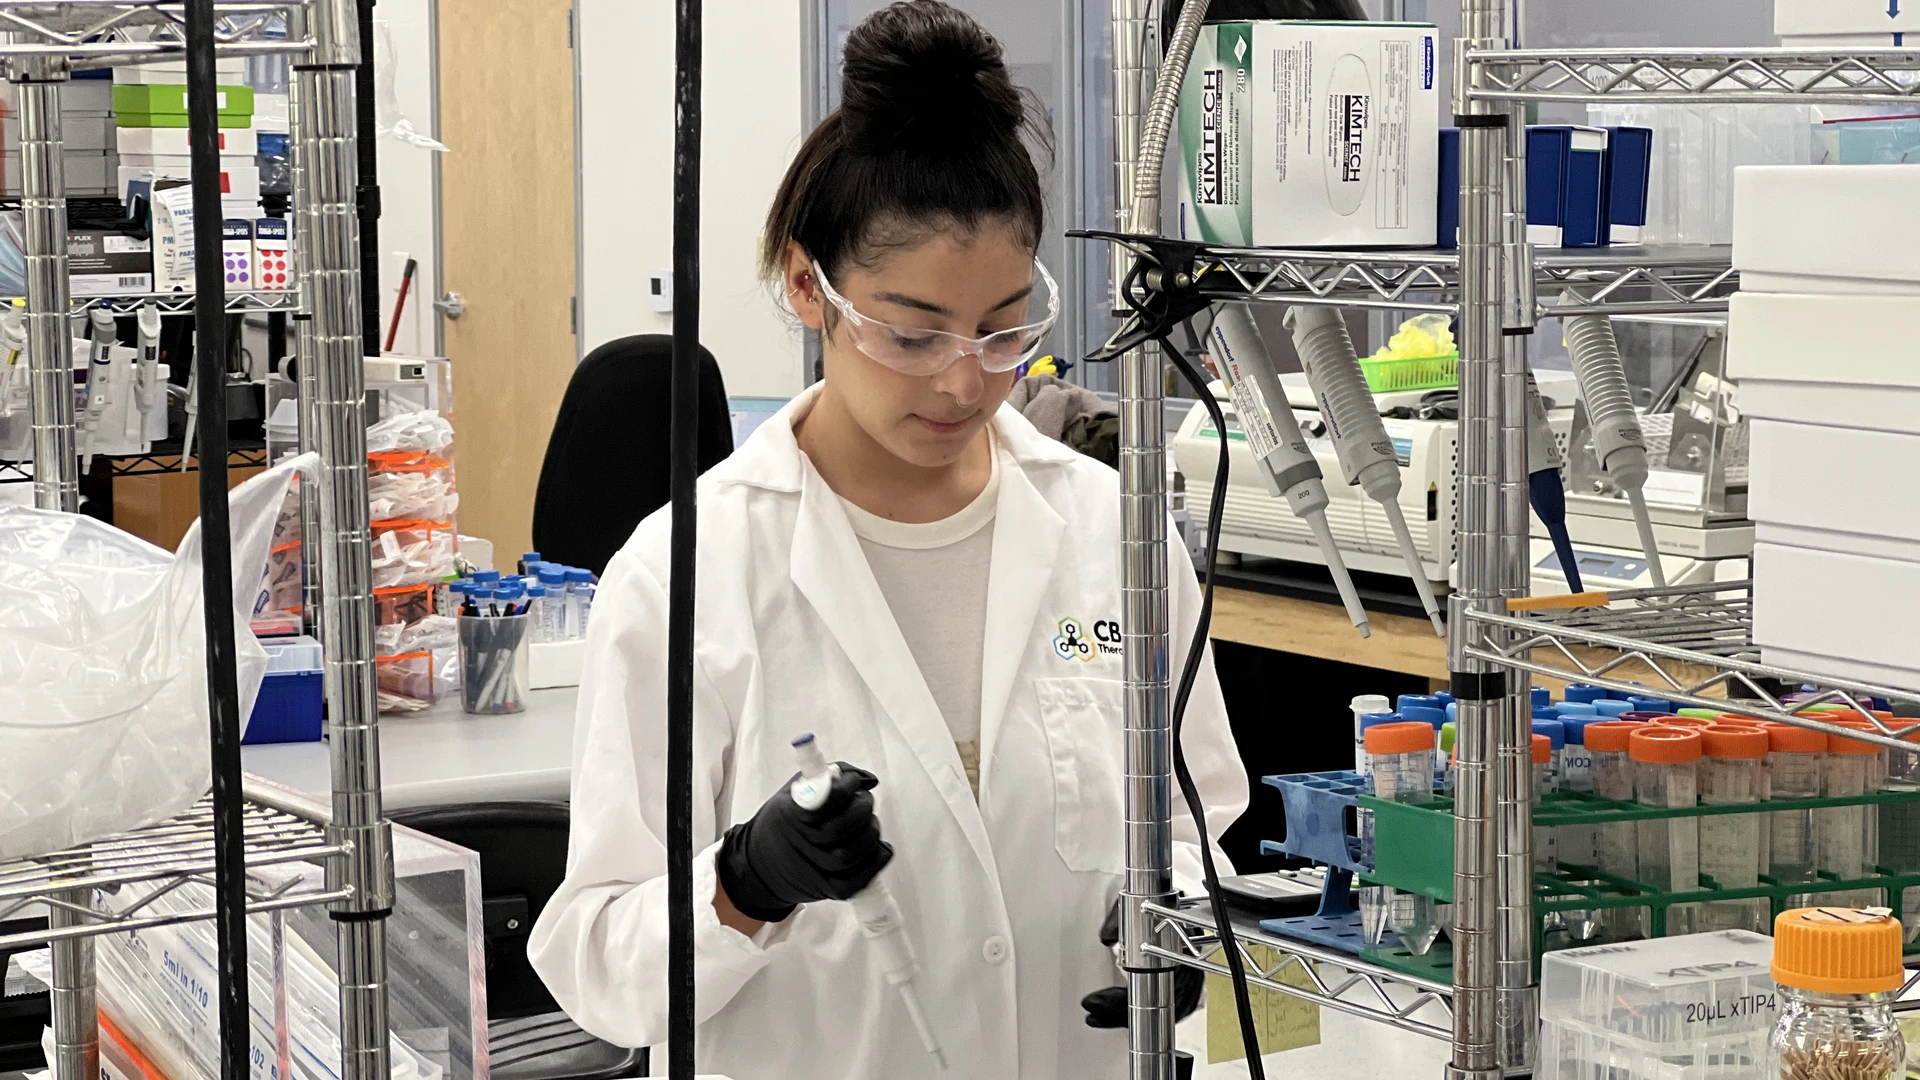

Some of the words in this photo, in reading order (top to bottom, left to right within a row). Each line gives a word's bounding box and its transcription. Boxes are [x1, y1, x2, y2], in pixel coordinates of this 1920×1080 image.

[1236, 68, 1246, 93] 280
[1203, 70, 1216, 204] KIMTECH
[1349, 95, 1363, 182] KIMTECH
[1216, 326, 1234, 362] eppendorf
[1322, 392, 1341, 439] eppendorf
[1266, 422, 1278, 446] sartorius
[1298, 490, 1310, 500] 200
[163, 950, 179, 975] 5ml
[180, 967, 188, 988] in
[191, 979, 208, 1009] 1/10
[1686, 1001, 1726, 1025] 20µL
[1730, 993, 1777, 1017] xTIP4
